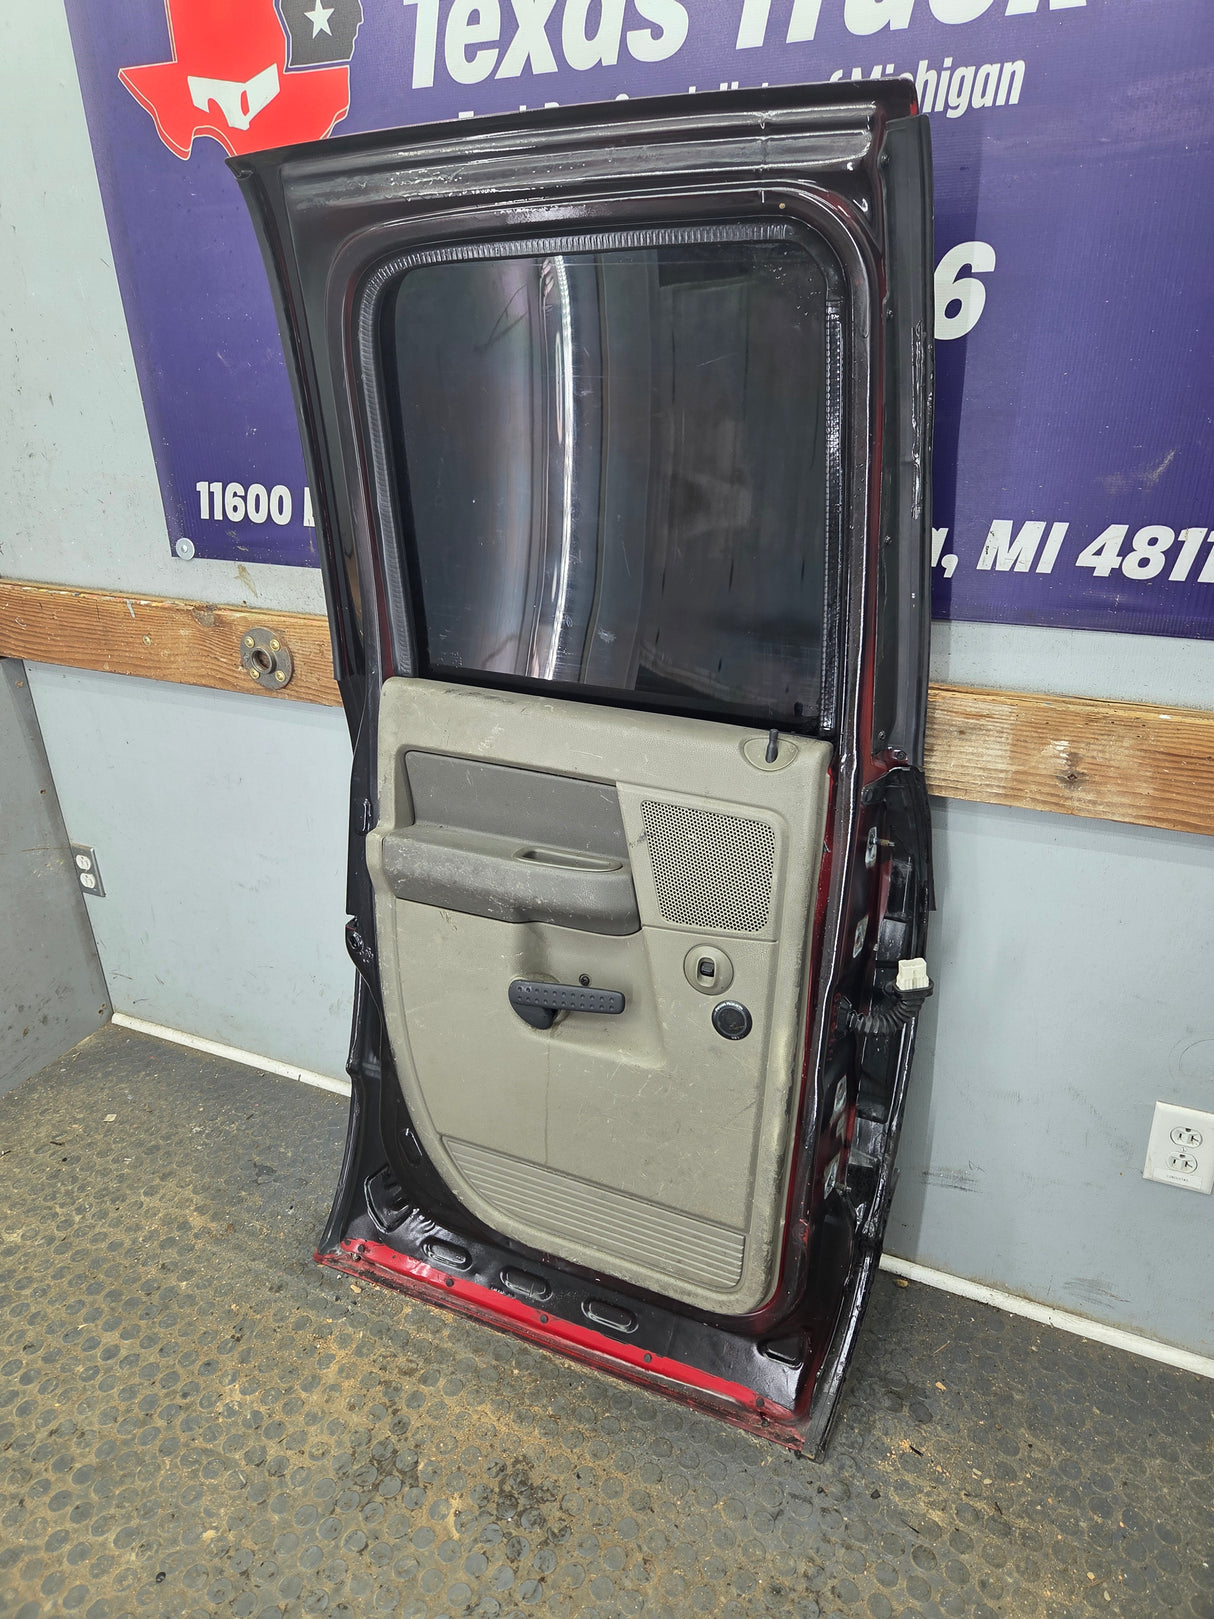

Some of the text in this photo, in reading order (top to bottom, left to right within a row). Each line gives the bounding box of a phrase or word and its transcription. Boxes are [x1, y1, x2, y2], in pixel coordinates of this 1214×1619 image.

[403, 0, 689, 89] Texas
[196, 481, 293, 526] 11600
[975, 519, 1070, 573] MI
